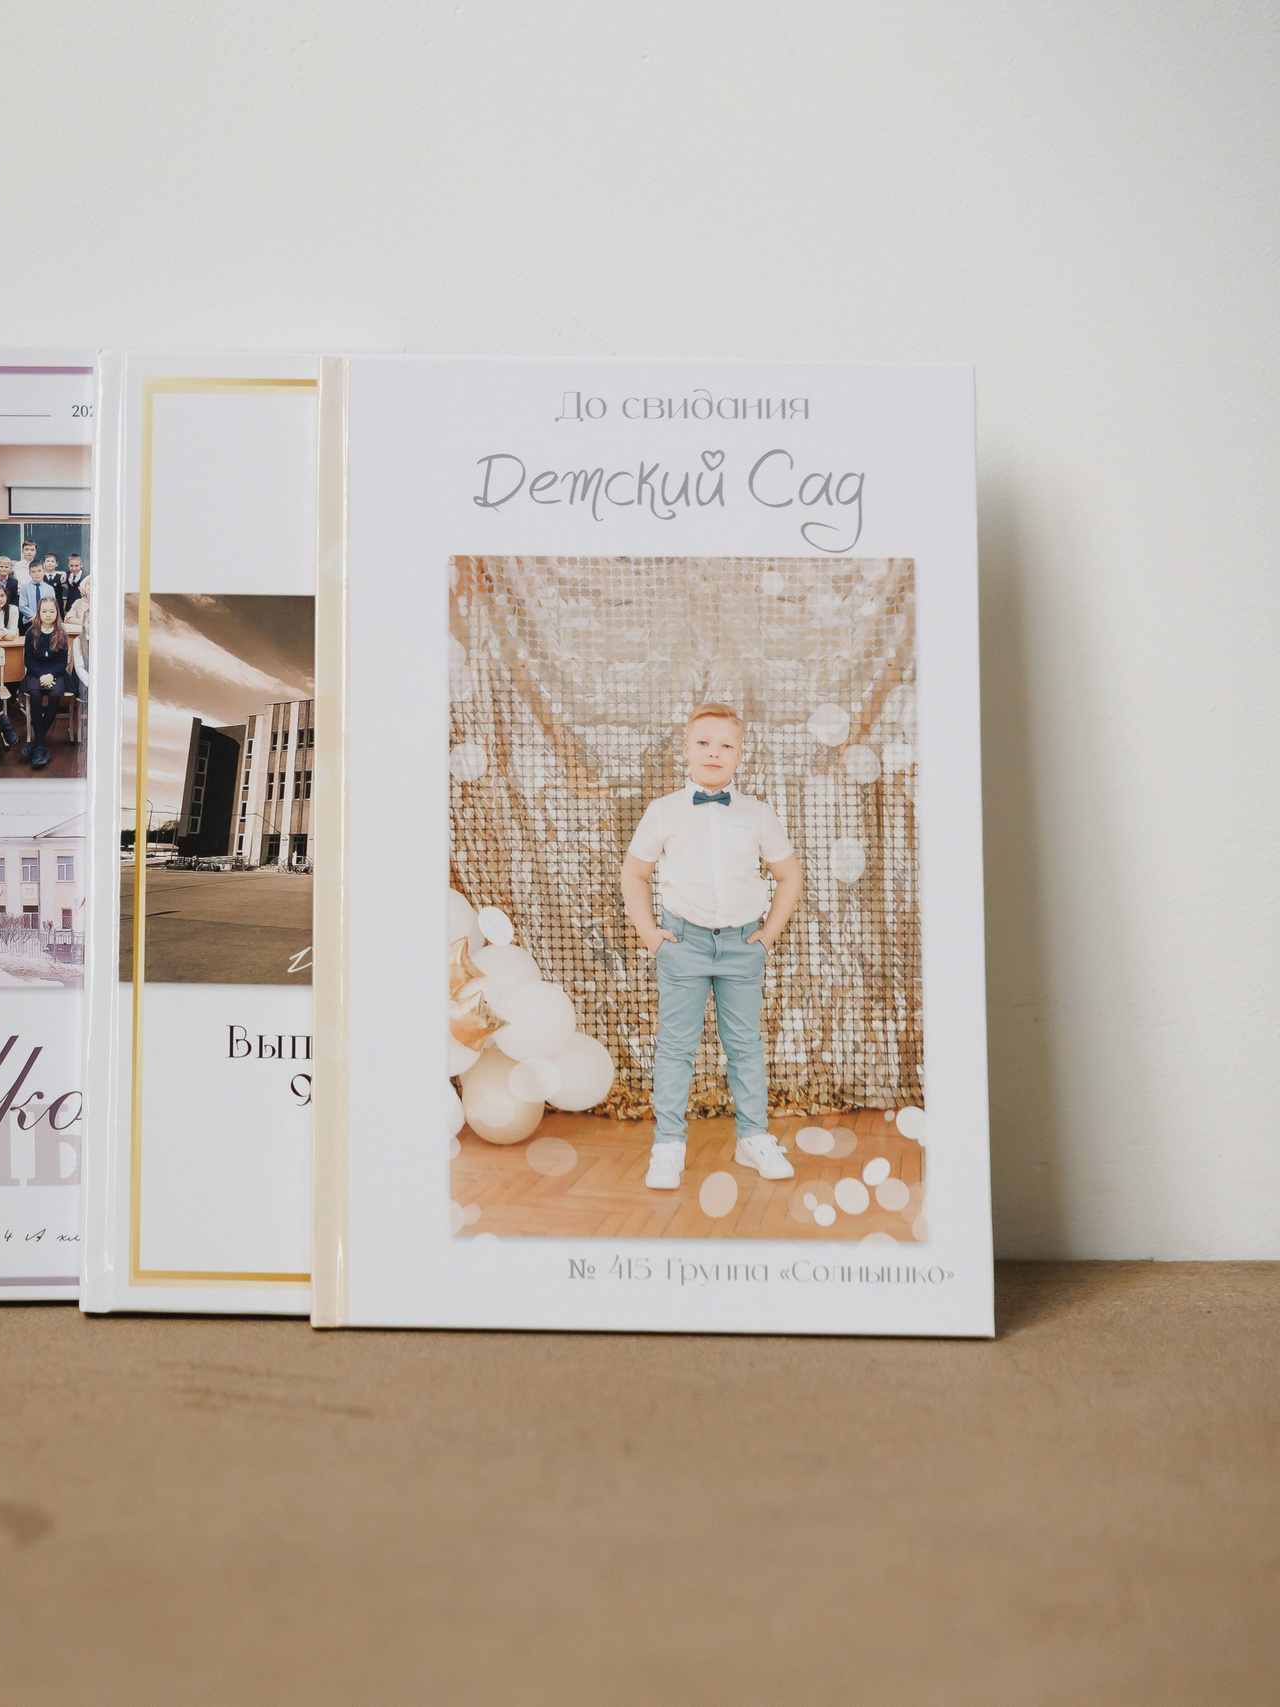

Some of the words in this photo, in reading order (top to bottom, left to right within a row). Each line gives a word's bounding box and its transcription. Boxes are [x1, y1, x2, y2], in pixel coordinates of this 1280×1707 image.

[554, 391, 608, 423] До
[621, 388, 810, 421] свидания
[472, 449, 726, 523] Детский
[747, 448, 867, 554] Сад
[225, 1024, 313, 1060] Вып
[3, 1229, 13, 1243] 4
[24, 1228, 47, 1243] А
[567, 1258, 596, 1280] №
[607, 1253, 653, 1280] 415
[666, 1258, 769, 1286] Группа
[779, 1259, 956, 1284] «Солнышко»
